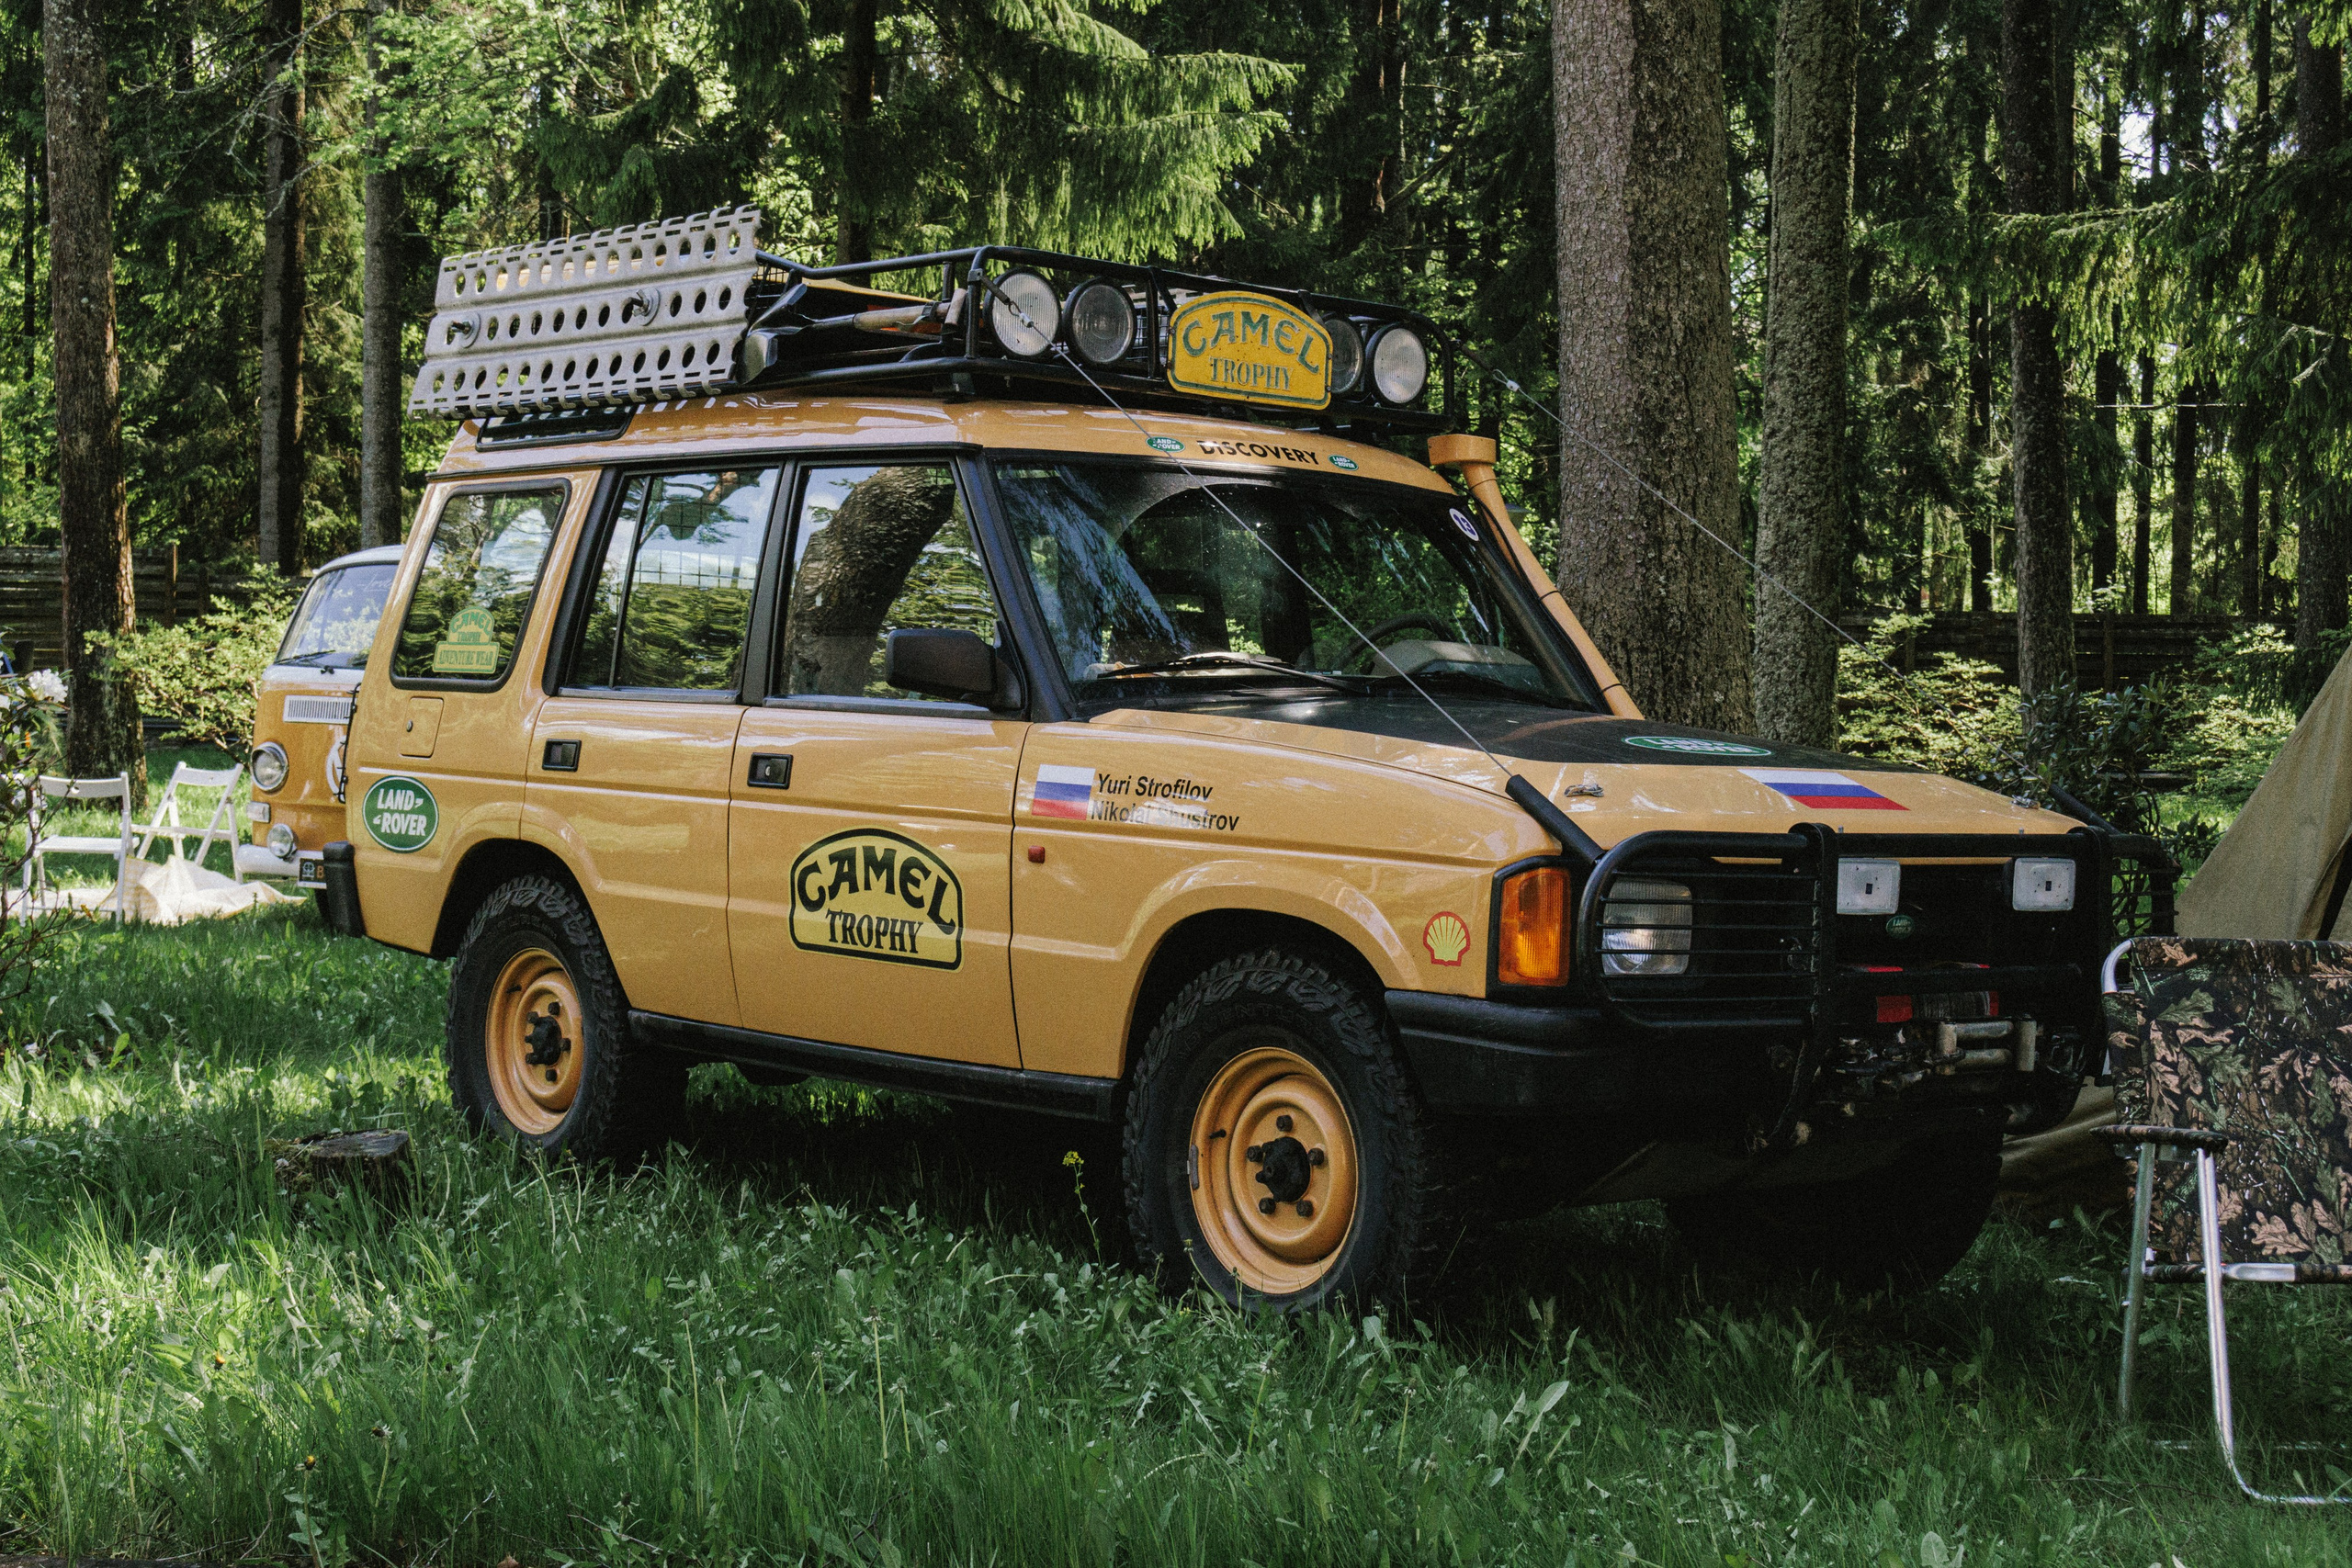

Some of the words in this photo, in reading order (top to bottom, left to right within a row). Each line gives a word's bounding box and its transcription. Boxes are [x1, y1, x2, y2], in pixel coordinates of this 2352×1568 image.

[1182, 310, 1319, 375] CAMEL
[1209, 355, 1294, 391] TROPHY
[1196, 440, 1320, 465] DISCOVERY
[450, 612, 492, 635] CAMEL
[439, 649, 474, 665] ADVENTURE
[476, 650, 494, 666] WEAR
[377, 788, 415, 811] LAND
[1098, 773, 1132, 795] Yuri
[1135, 775, 1213, 801] Strofilov
[380, 812, 427, 836] ROVER
[797, 845, 956, 935] CAMEL
[825, 908, 923, 953] TROPHY
